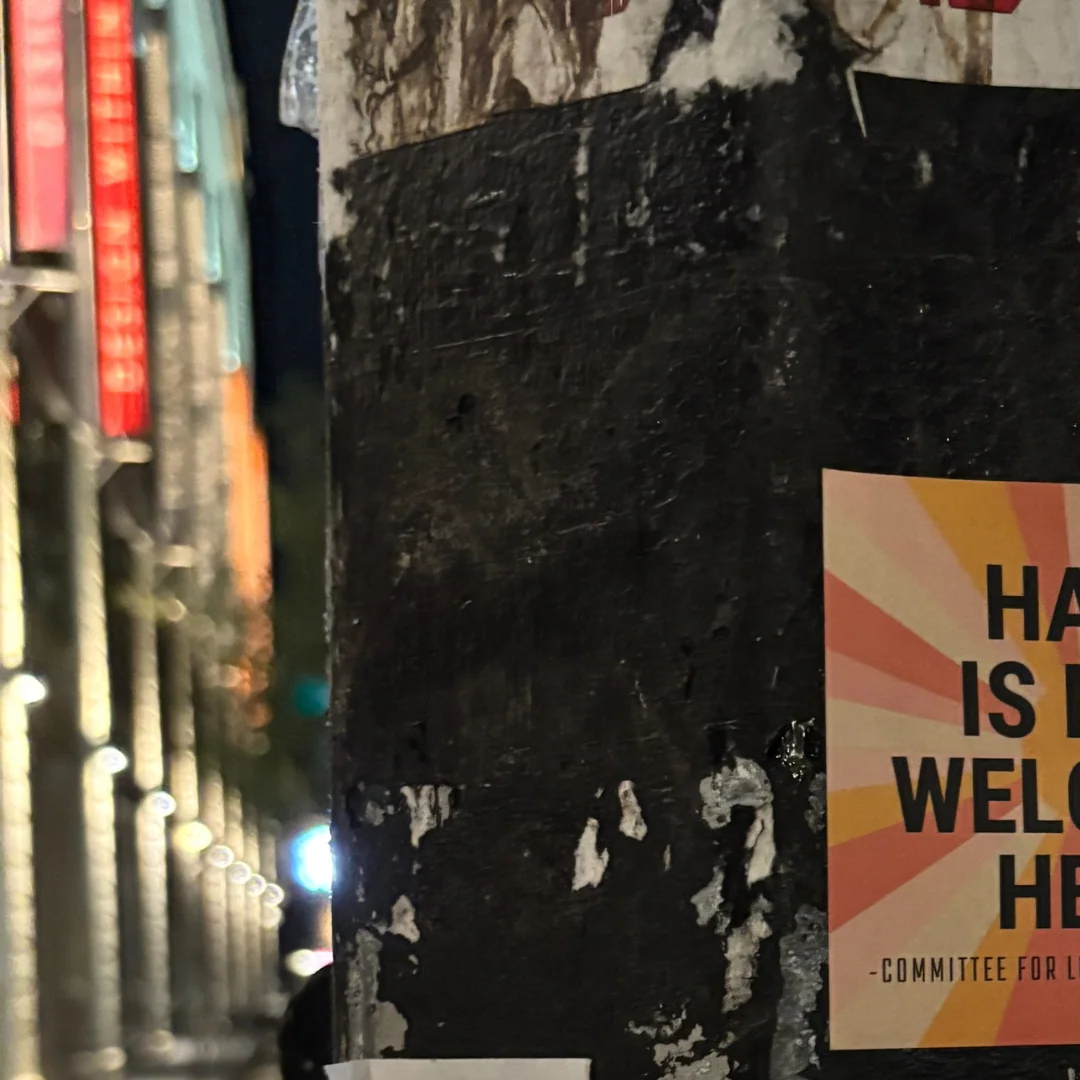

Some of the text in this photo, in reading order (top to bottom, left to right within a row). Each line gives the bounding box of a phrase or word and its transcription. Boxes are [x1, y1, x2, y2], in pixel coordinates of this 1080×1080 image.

[962, 661, 1036, 739] IS
[869, 956, 1007, 983] -COMMITTEE
[1018, 955, 1057, 981] FOR
